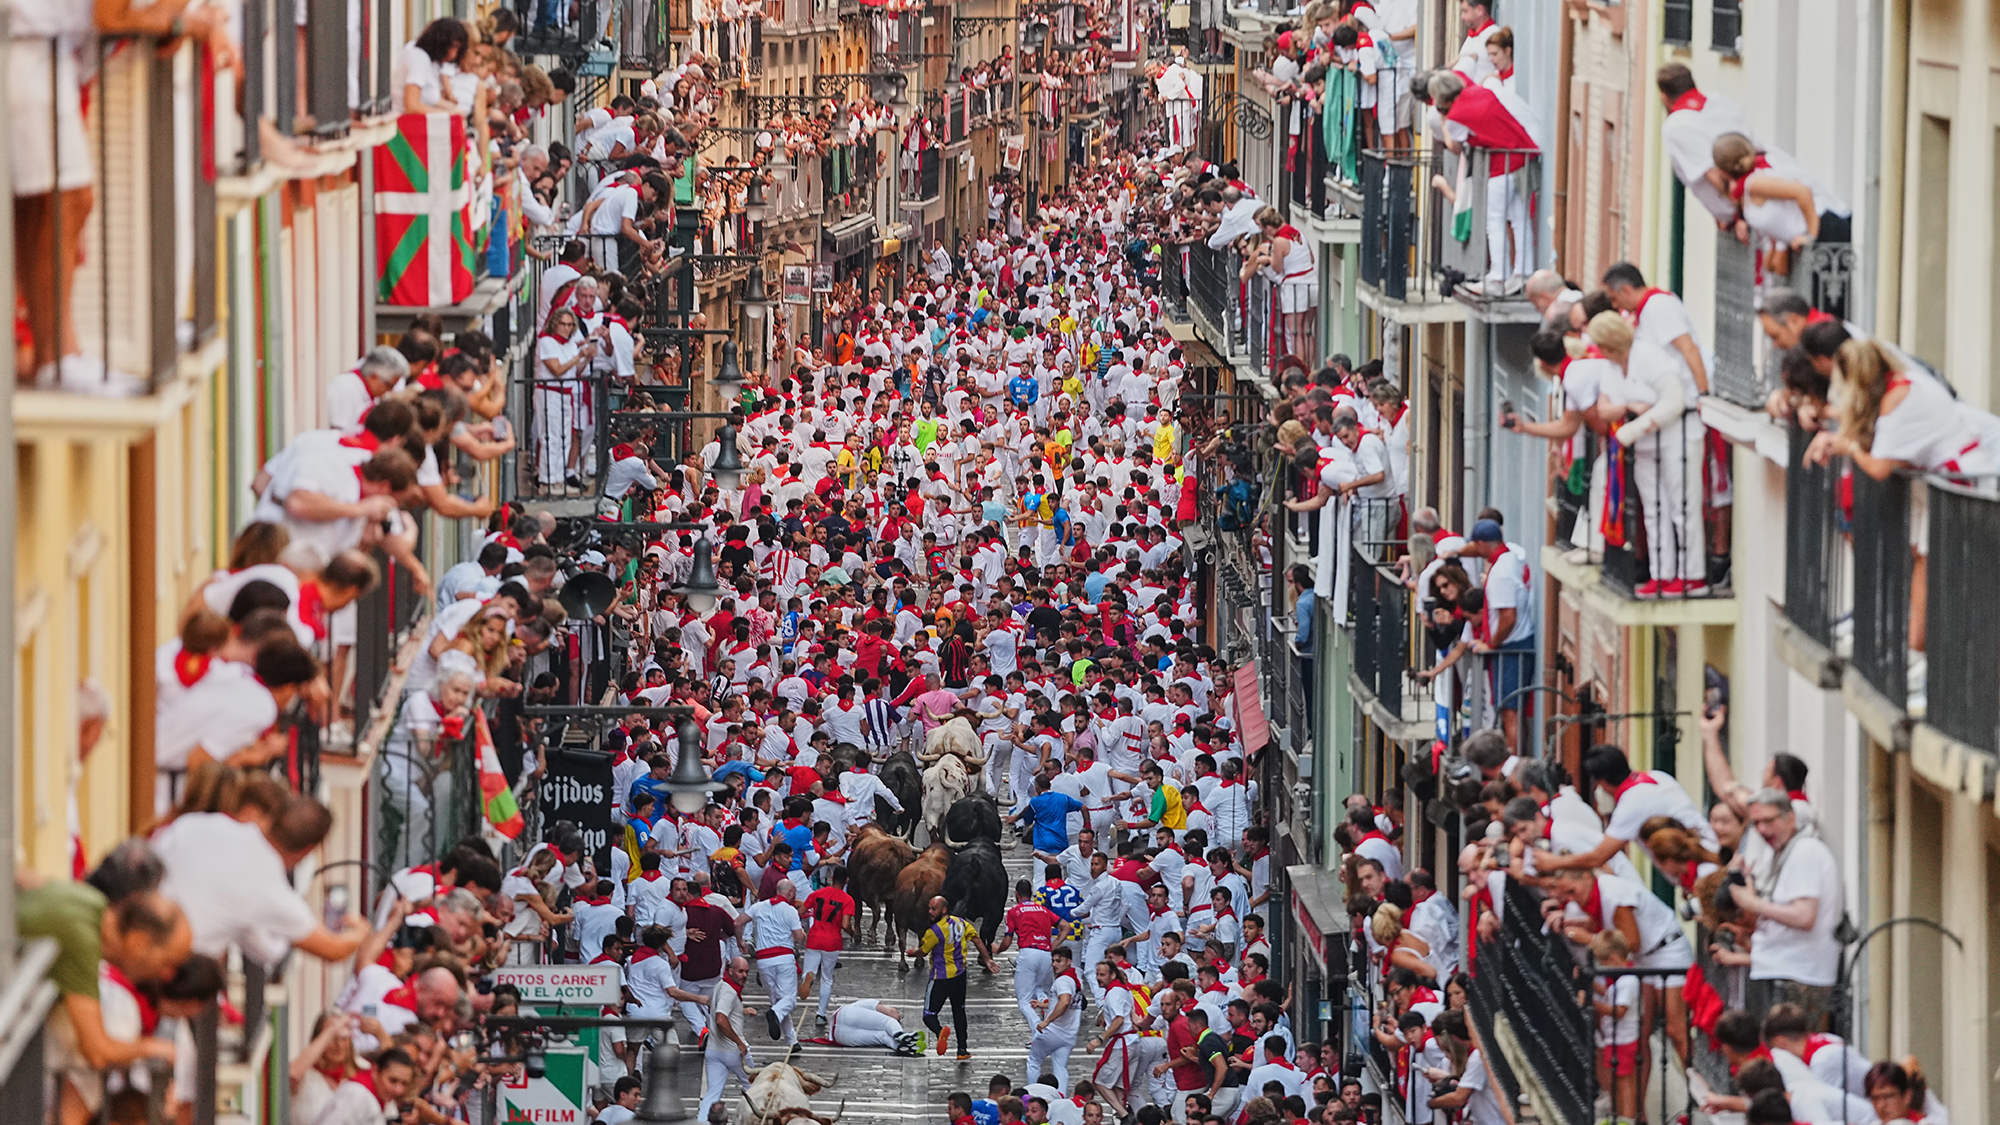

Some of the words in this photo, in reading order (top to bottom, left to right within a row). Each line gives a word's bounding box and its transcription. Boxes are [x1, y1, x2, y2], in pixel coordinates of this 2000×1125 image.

[539, 768, 604, 811] ejidos
[1046, 886, 1077, 907] 22
[815, 897, 843, 922] 17
[497, 974, 544, 985] FOTOS
[550, 974, 607, 985] CARNET
[518, 987, 529, 997] N
[534, 987, 549, 997] EL
[555, 987, 593, 997] ACTO
